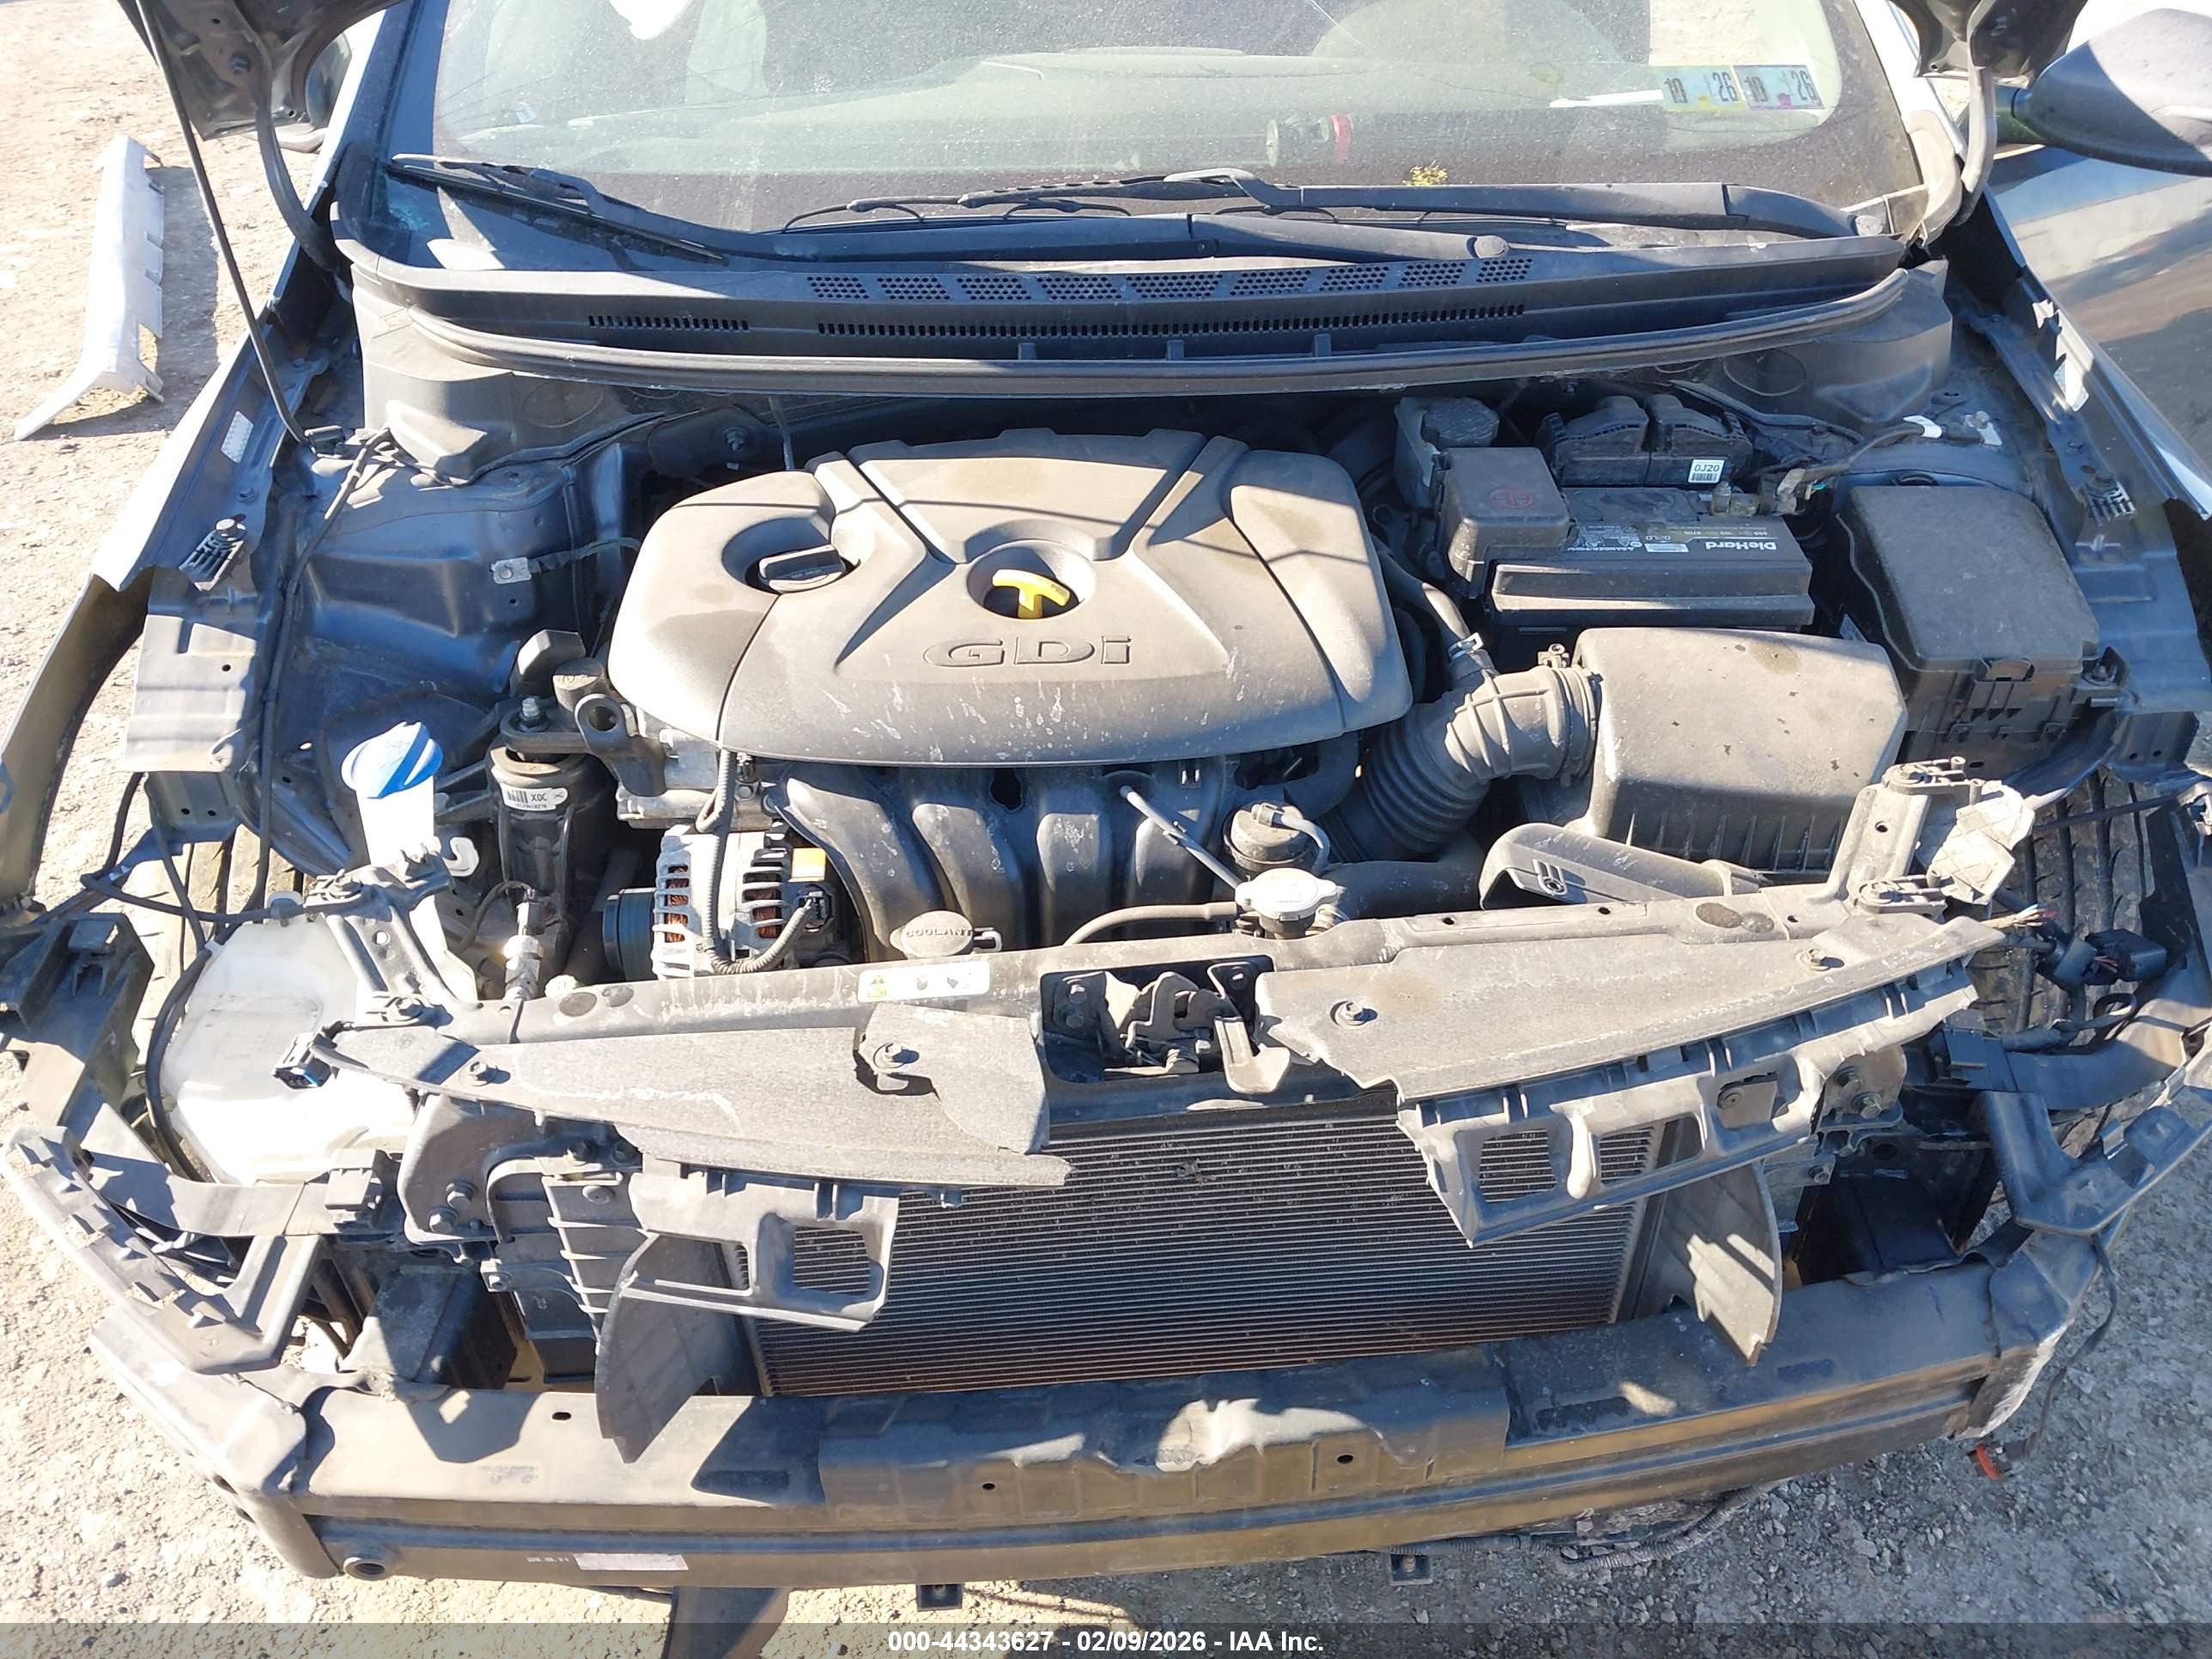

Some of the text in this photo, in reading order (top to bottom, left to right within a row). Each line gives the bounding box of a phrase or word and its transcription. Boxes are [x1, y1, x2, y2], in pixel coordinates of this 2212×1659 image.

[1712, 71, 1739, 102] 26
[1790, 70, 1818, 101] 26
[1705, 541, 1778, 550] DieHard
[905, 927, 974, 939] COOLANT
